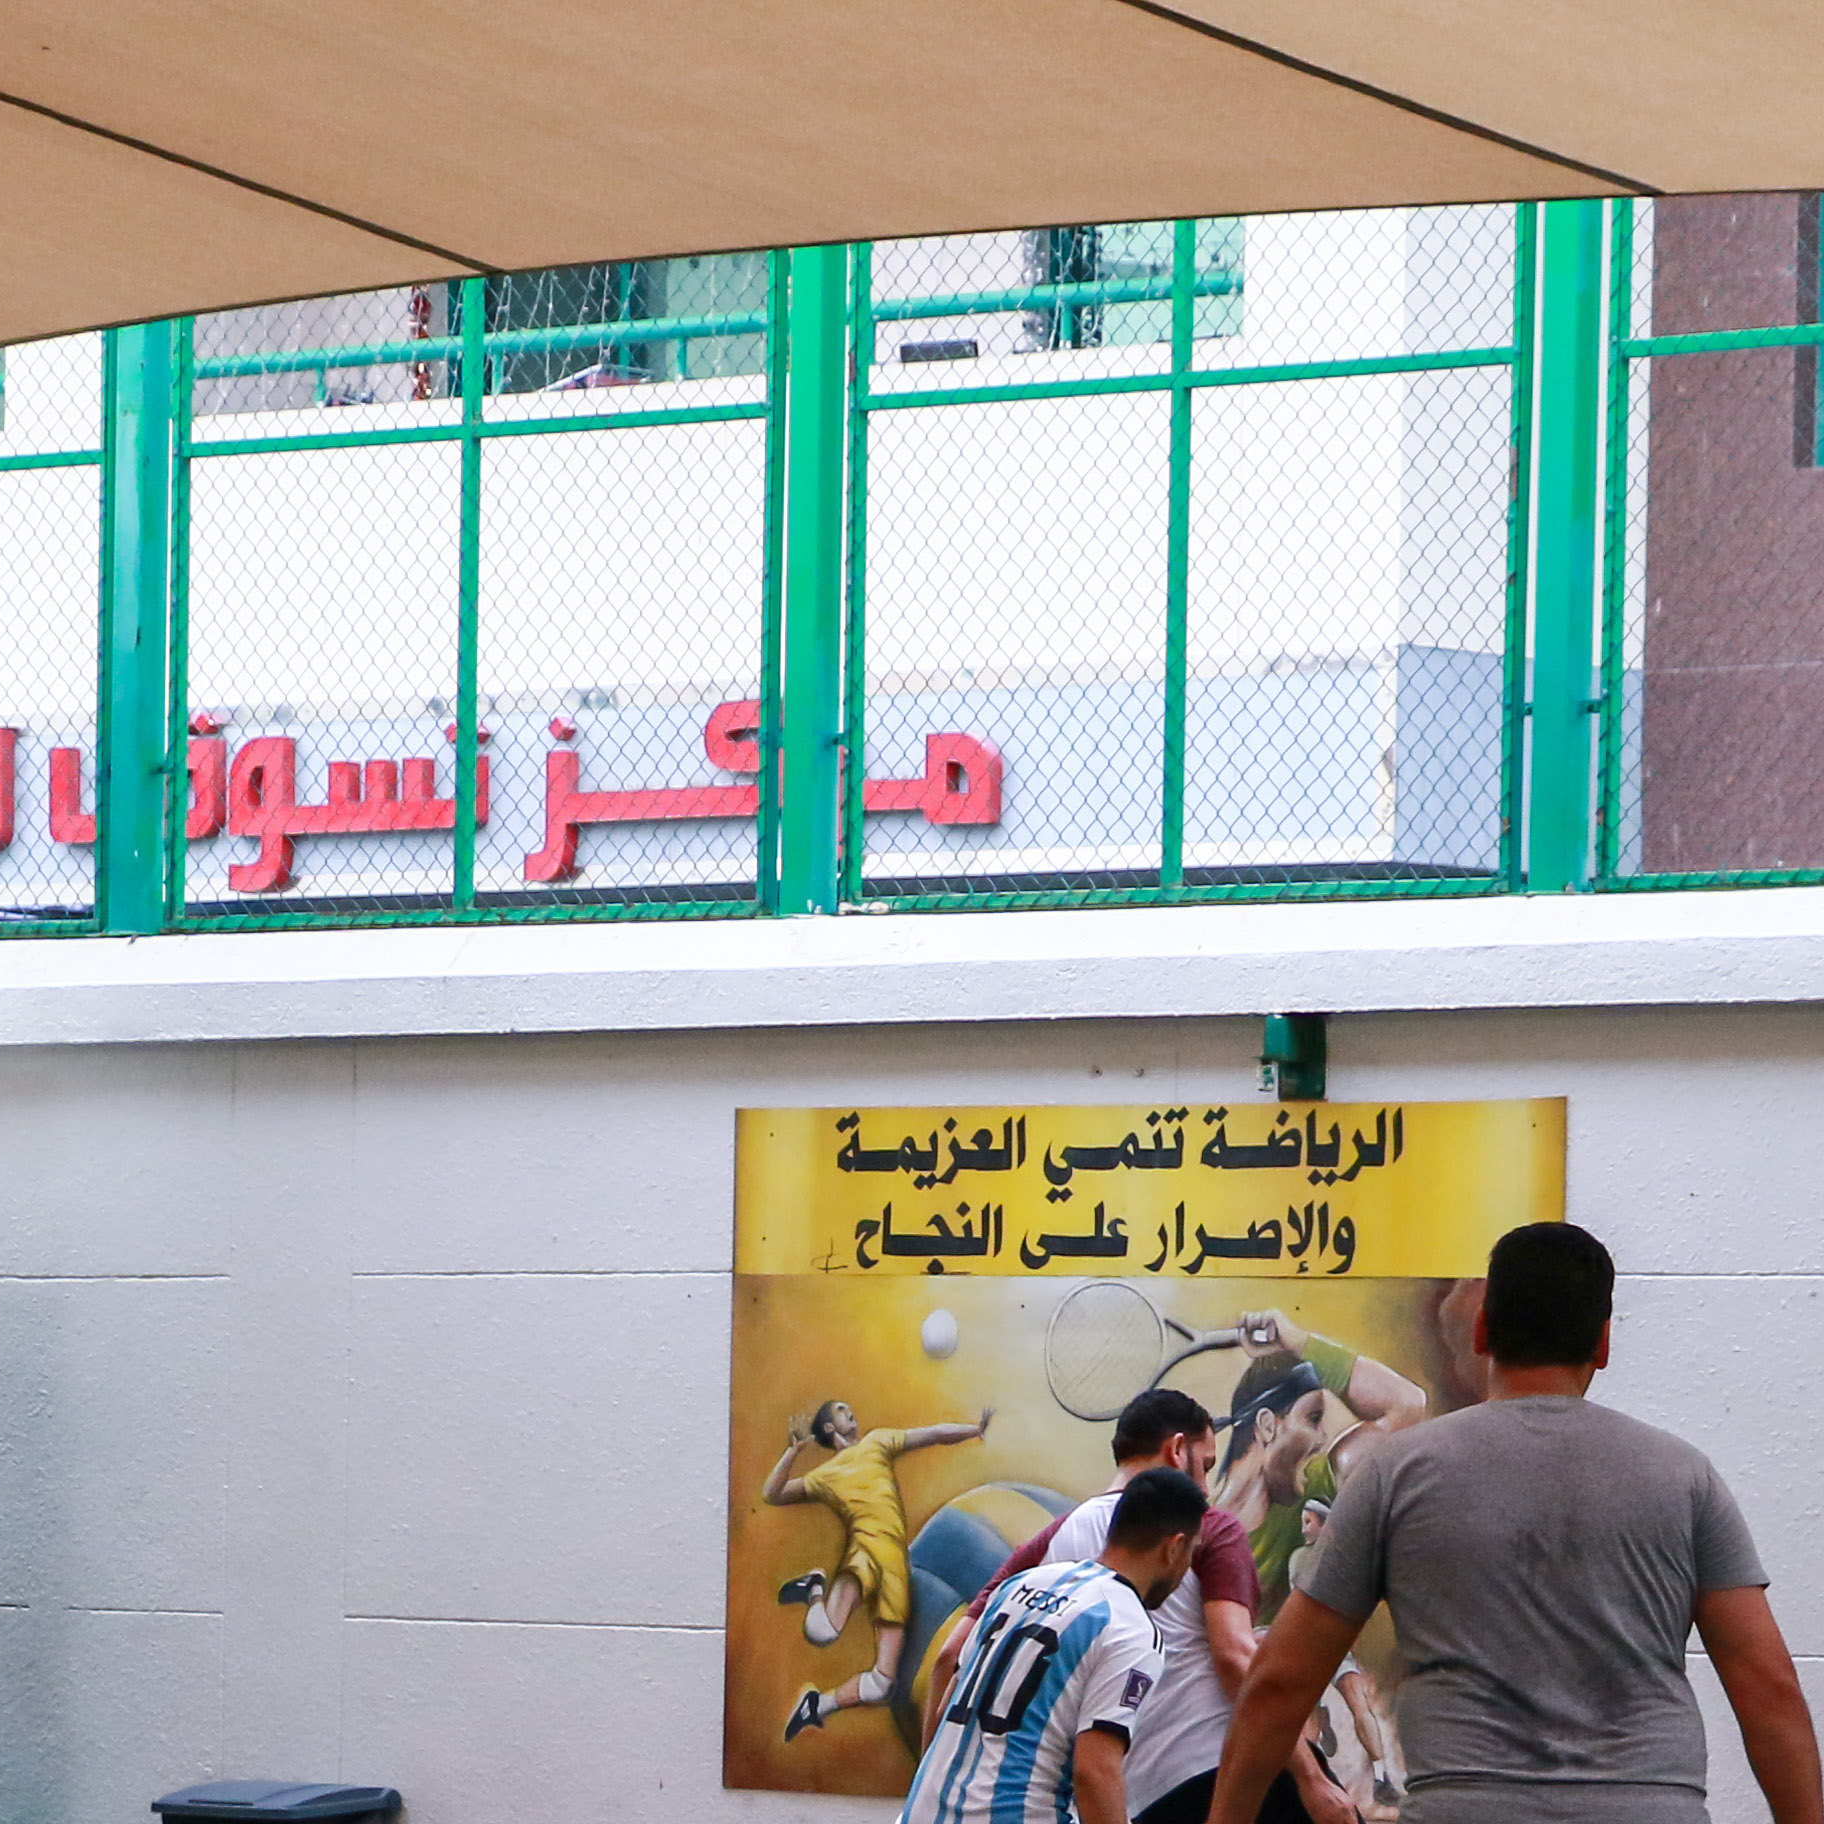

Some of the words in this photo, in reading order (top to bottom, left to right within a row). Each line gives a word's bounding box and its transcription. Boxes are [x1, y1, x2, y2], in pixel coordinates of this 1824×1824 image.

[523, 699, 1003, 882] مكز
[836, 1112, 1027, 1191] العزيمة
[1043, 1106, 1189, 1204] تنمي
[1200, 1106, 1404, 1188] الرياضة
[854, 1202, 1004, 1277] النجاح
[1019, 1200, 1130, 1271] على
[1143, 1201, 1357, 1276] والإصرار
[1010, 1583, 1079, 1617] MESSI
[945, 1612, 1060, 1736] 10
